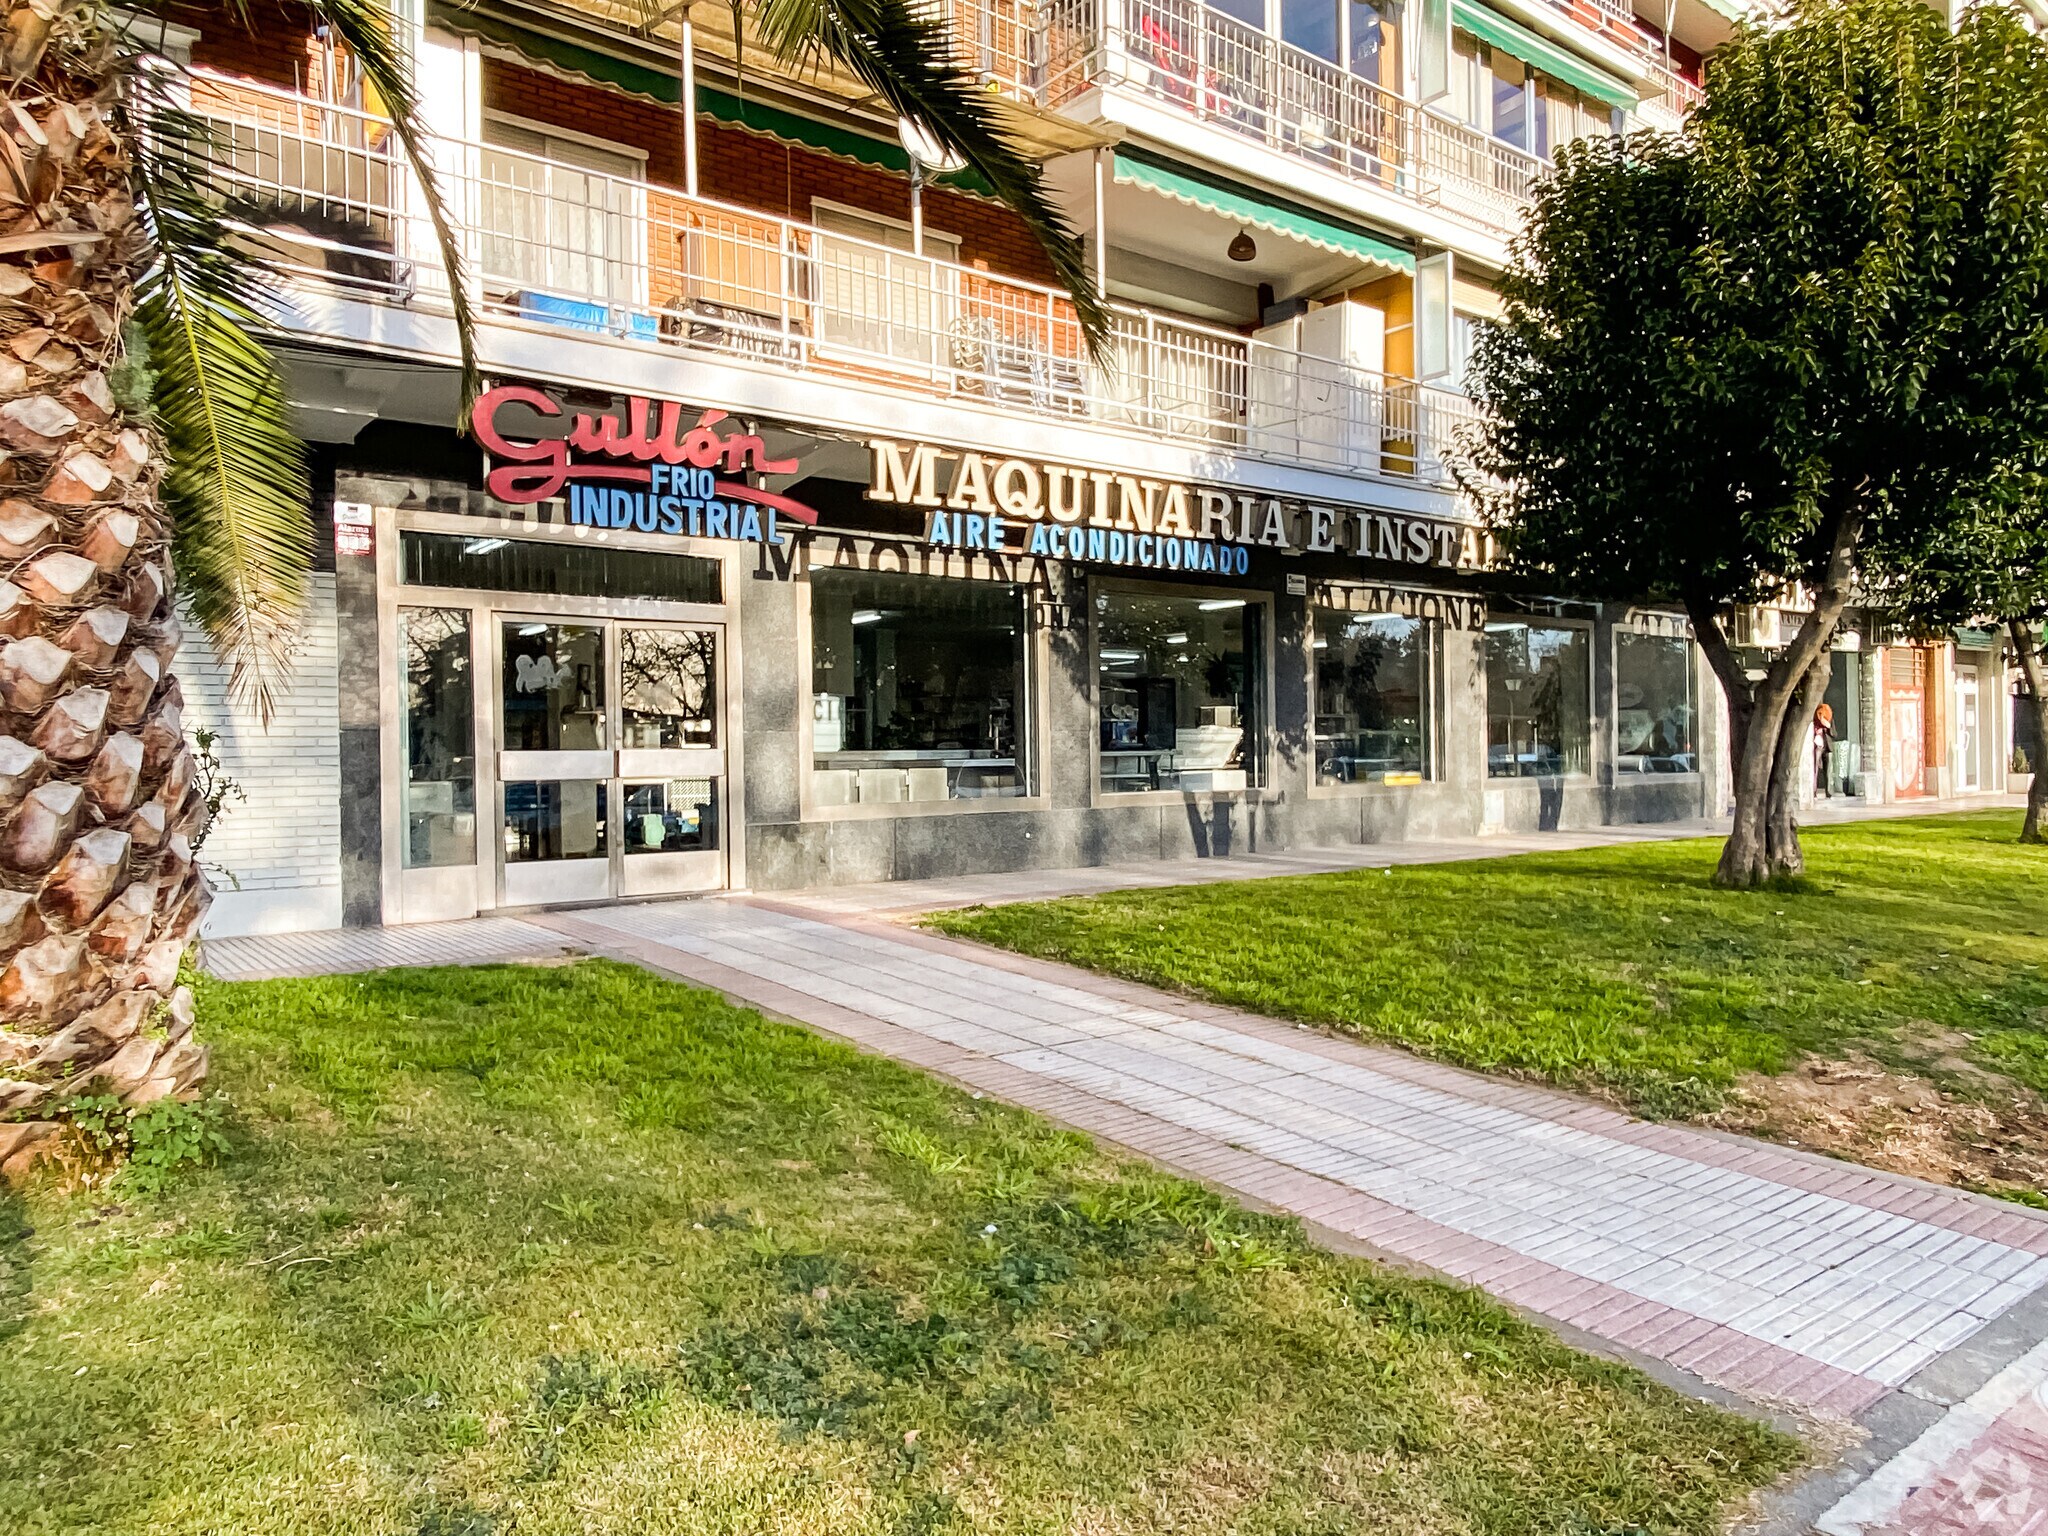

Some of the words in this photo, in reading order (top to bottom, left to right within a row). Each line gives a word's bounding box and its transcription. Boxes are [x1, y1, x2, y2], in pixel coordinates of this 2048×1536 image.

[472, 386, 818, 507] Gullón
[571, 484, 785, 544] INDUSTRIAL
[652, 464, 715, 500] FRIO
[867, 441, 1290, 549] MAQUINARIA
[1306, 506, 1336, 554] E
[929, 510, 1005, 550] AIRE
[1029, 523, 1249, 575] ACONDICIONADO
